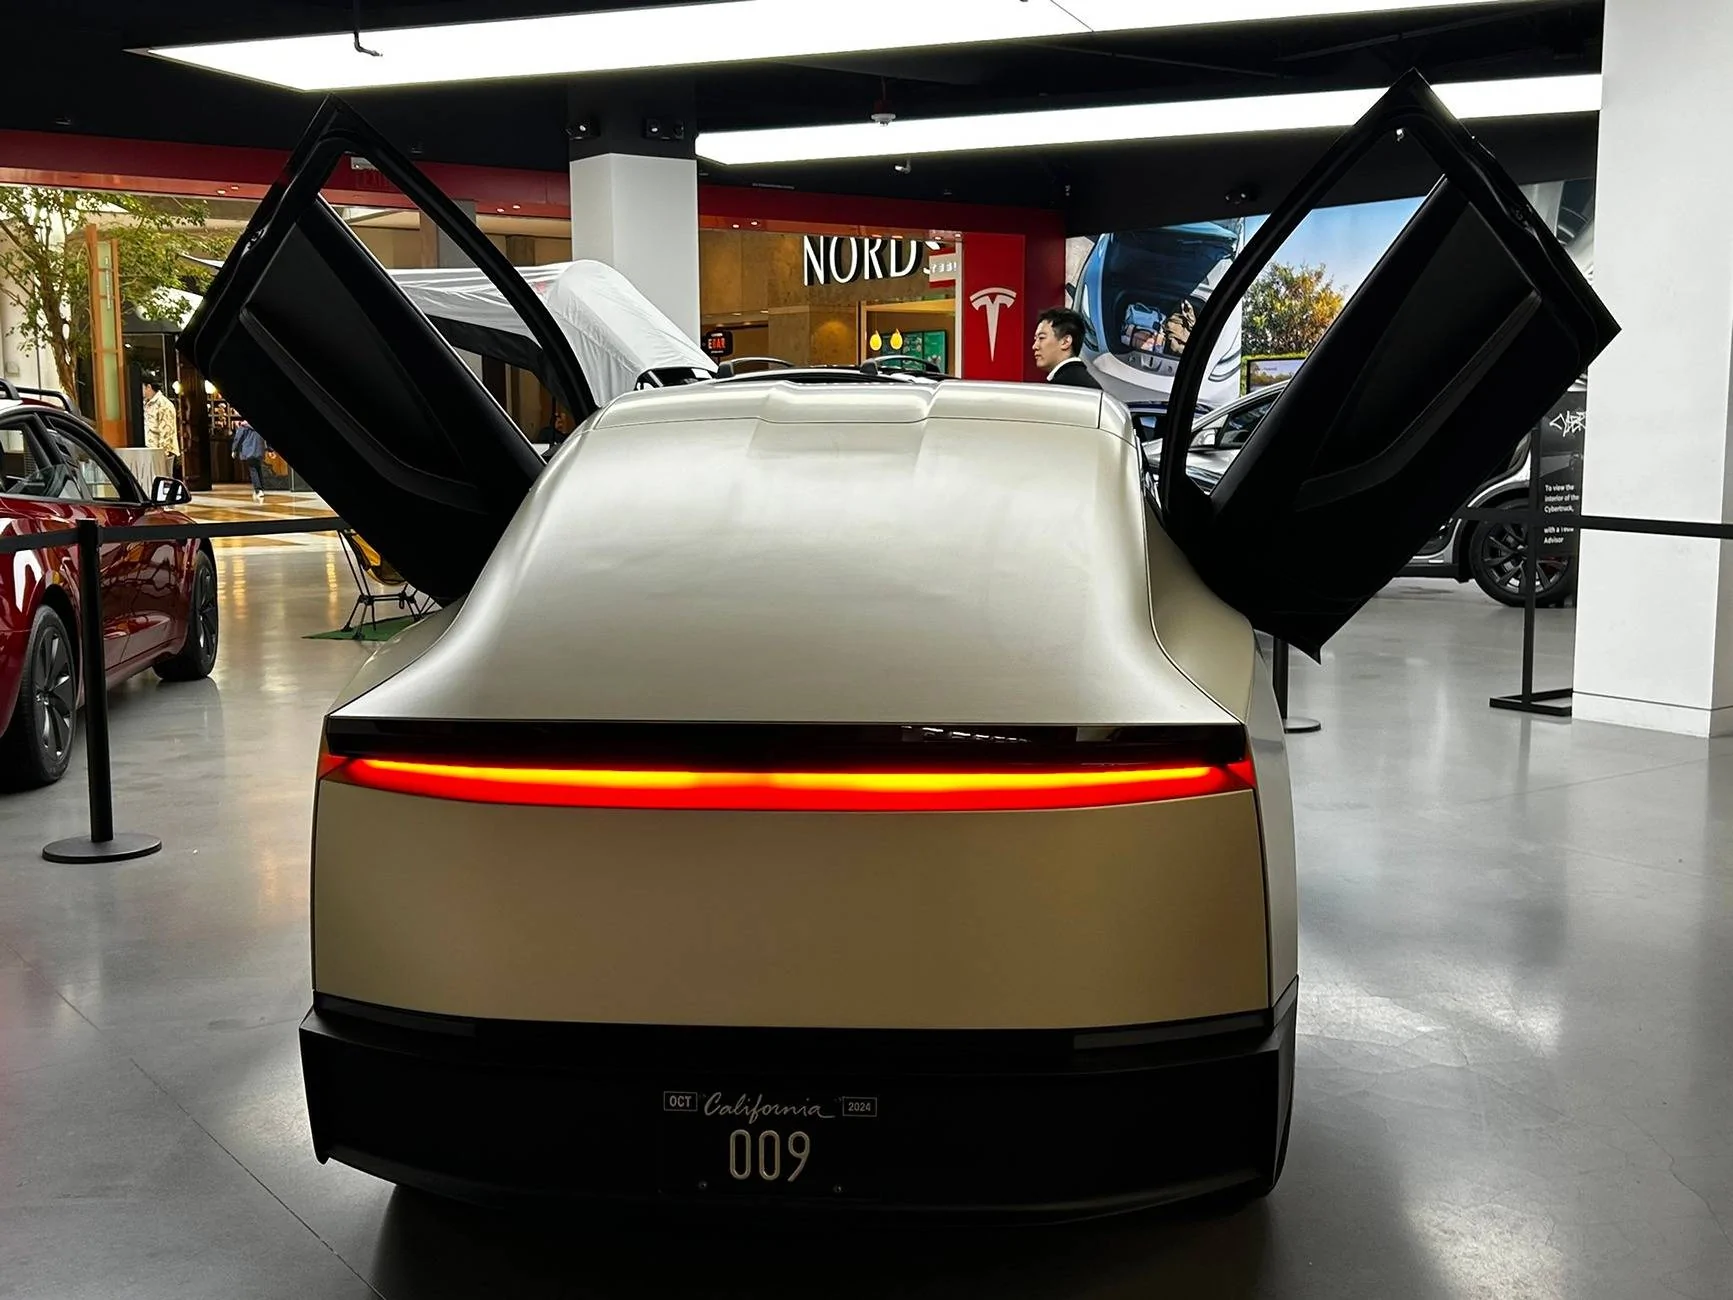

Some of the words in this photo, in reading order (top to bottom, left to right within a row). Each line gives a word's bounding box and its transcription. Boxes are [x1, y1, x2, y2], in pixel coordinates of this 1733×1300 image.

[1544, 536, 1564, 544] Advisor
[669, 1095, 692, 1108] OCT
[704, 1091, 836, 1124] California
[848, 1102, 871, 1112] 2024
[729, 1129, 811, 1182] 009
